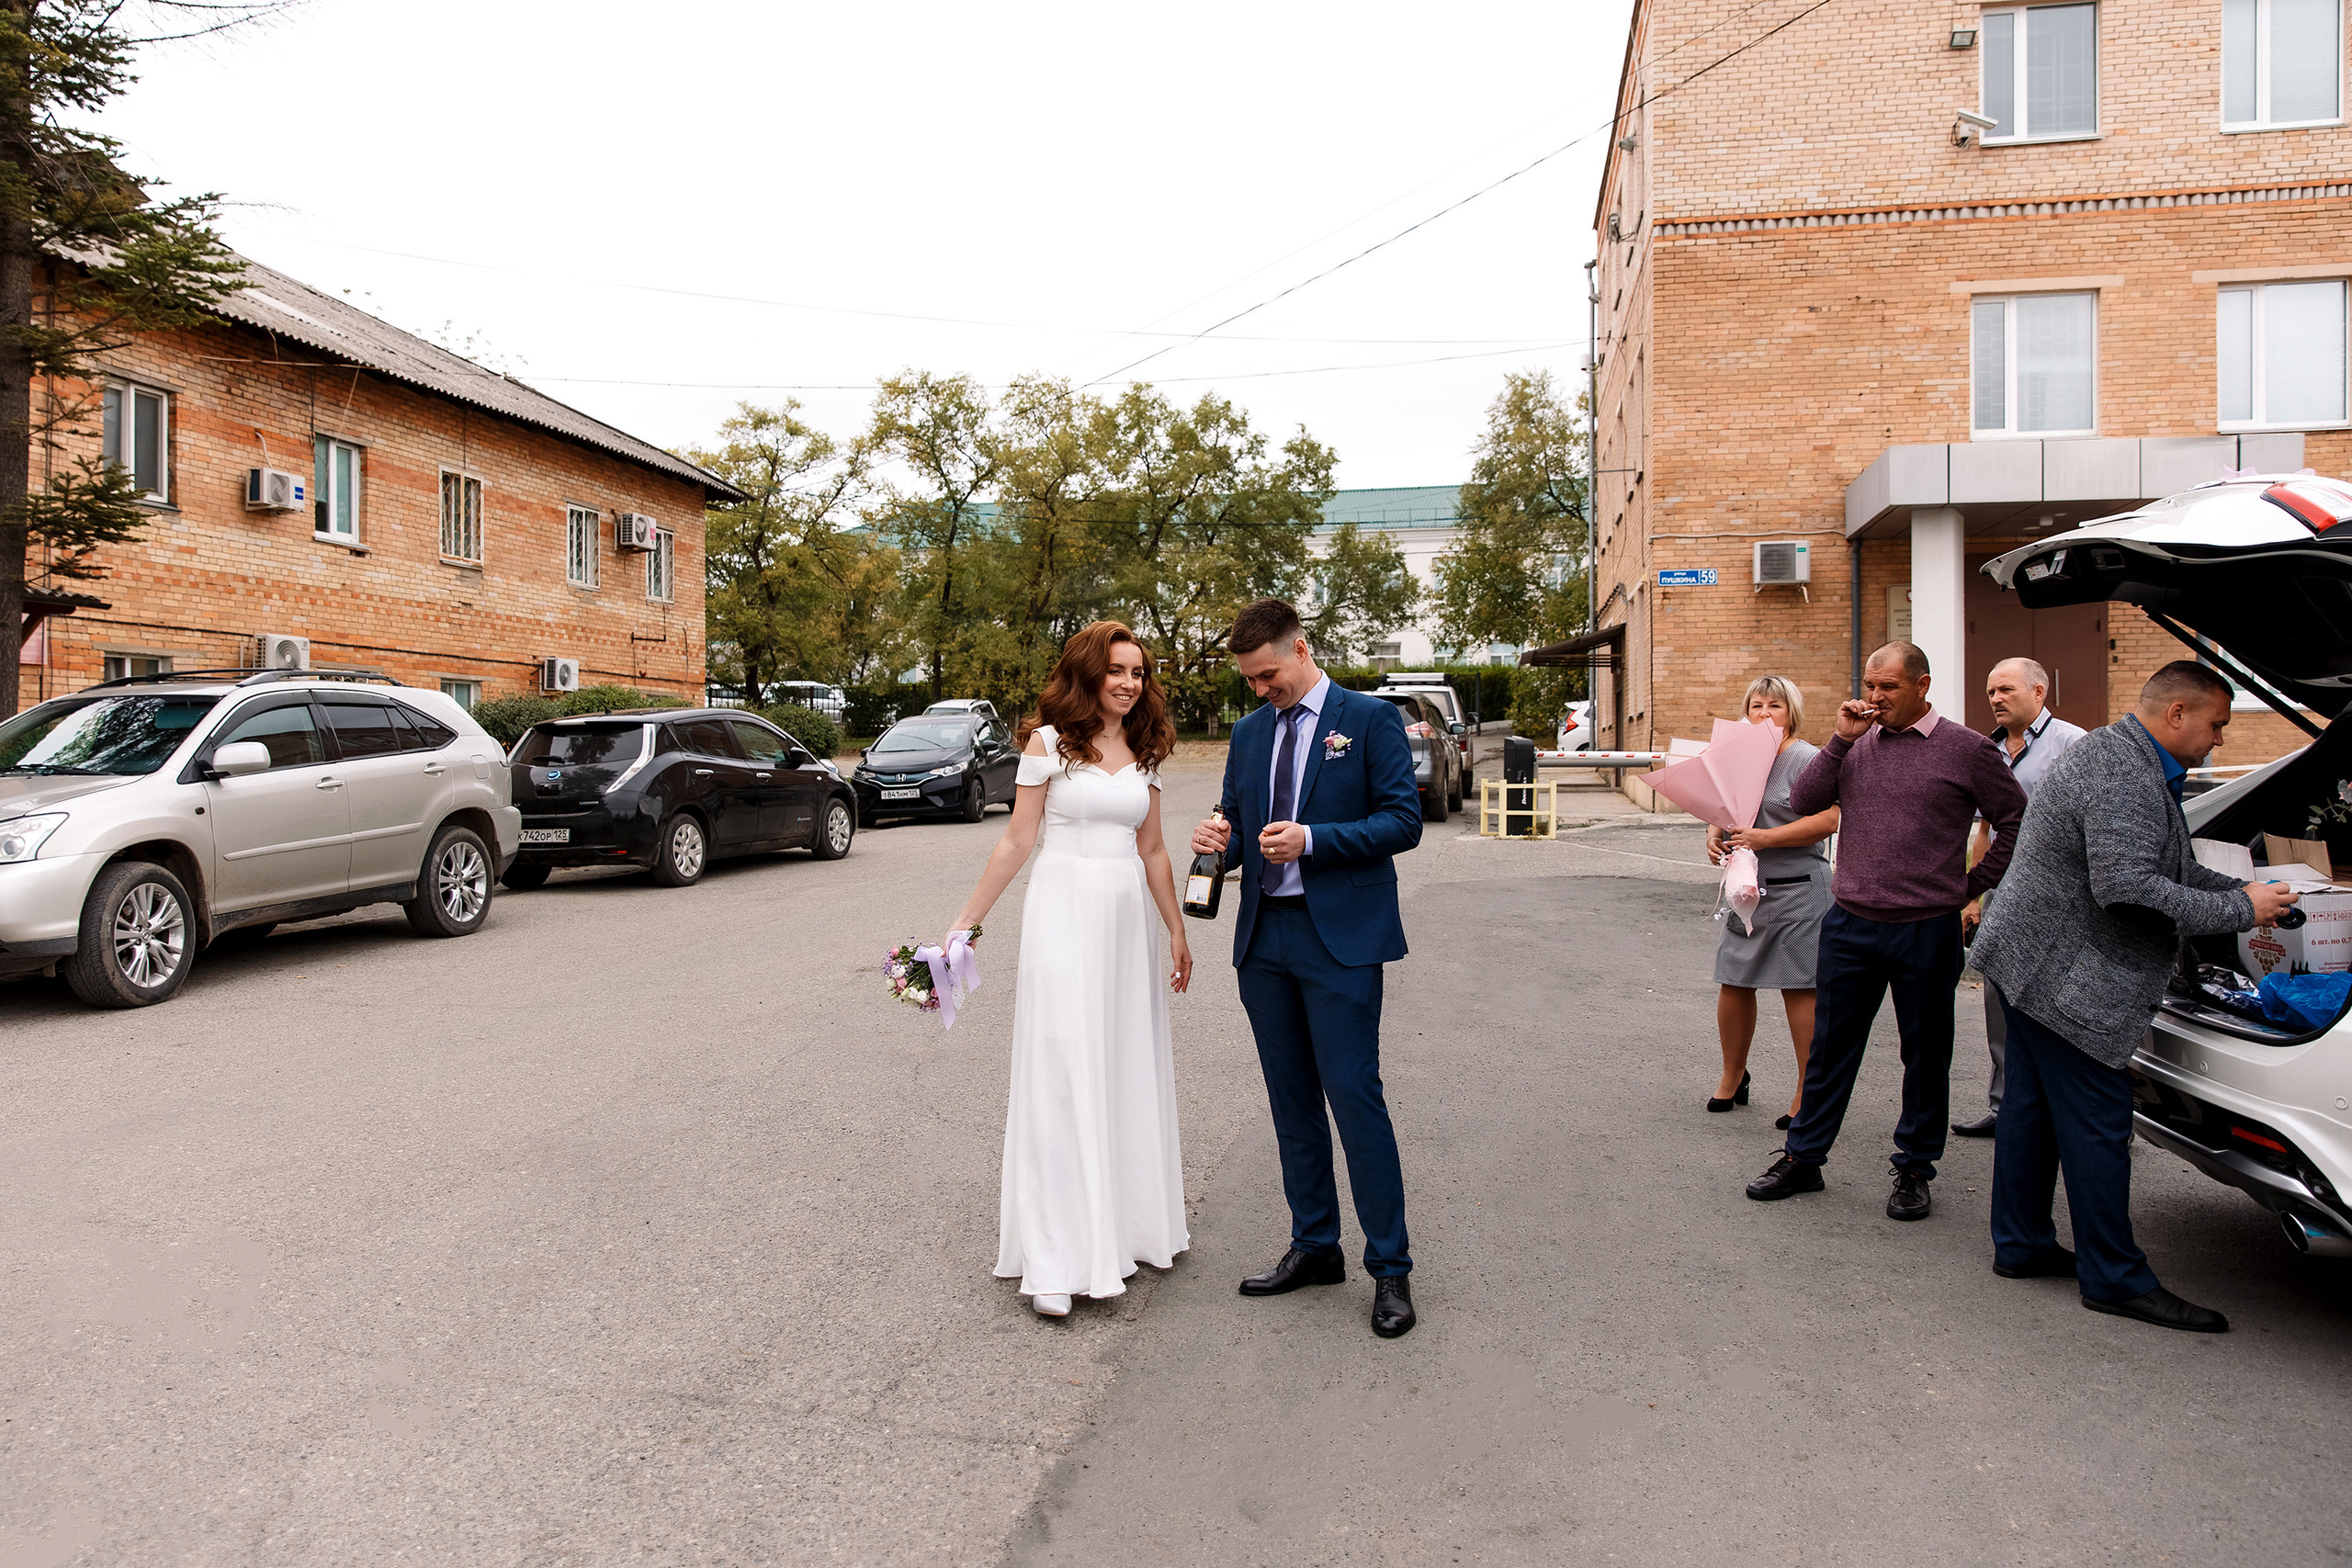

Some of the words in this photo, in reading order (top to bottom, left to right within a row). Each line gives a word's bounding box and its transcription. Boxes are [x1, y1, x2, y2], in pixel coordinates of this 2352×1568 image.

[1701, 570, 1715, 583] 59
[518, 830, 552, 841] К742ОР
[553, 829, 568, 838] 125
